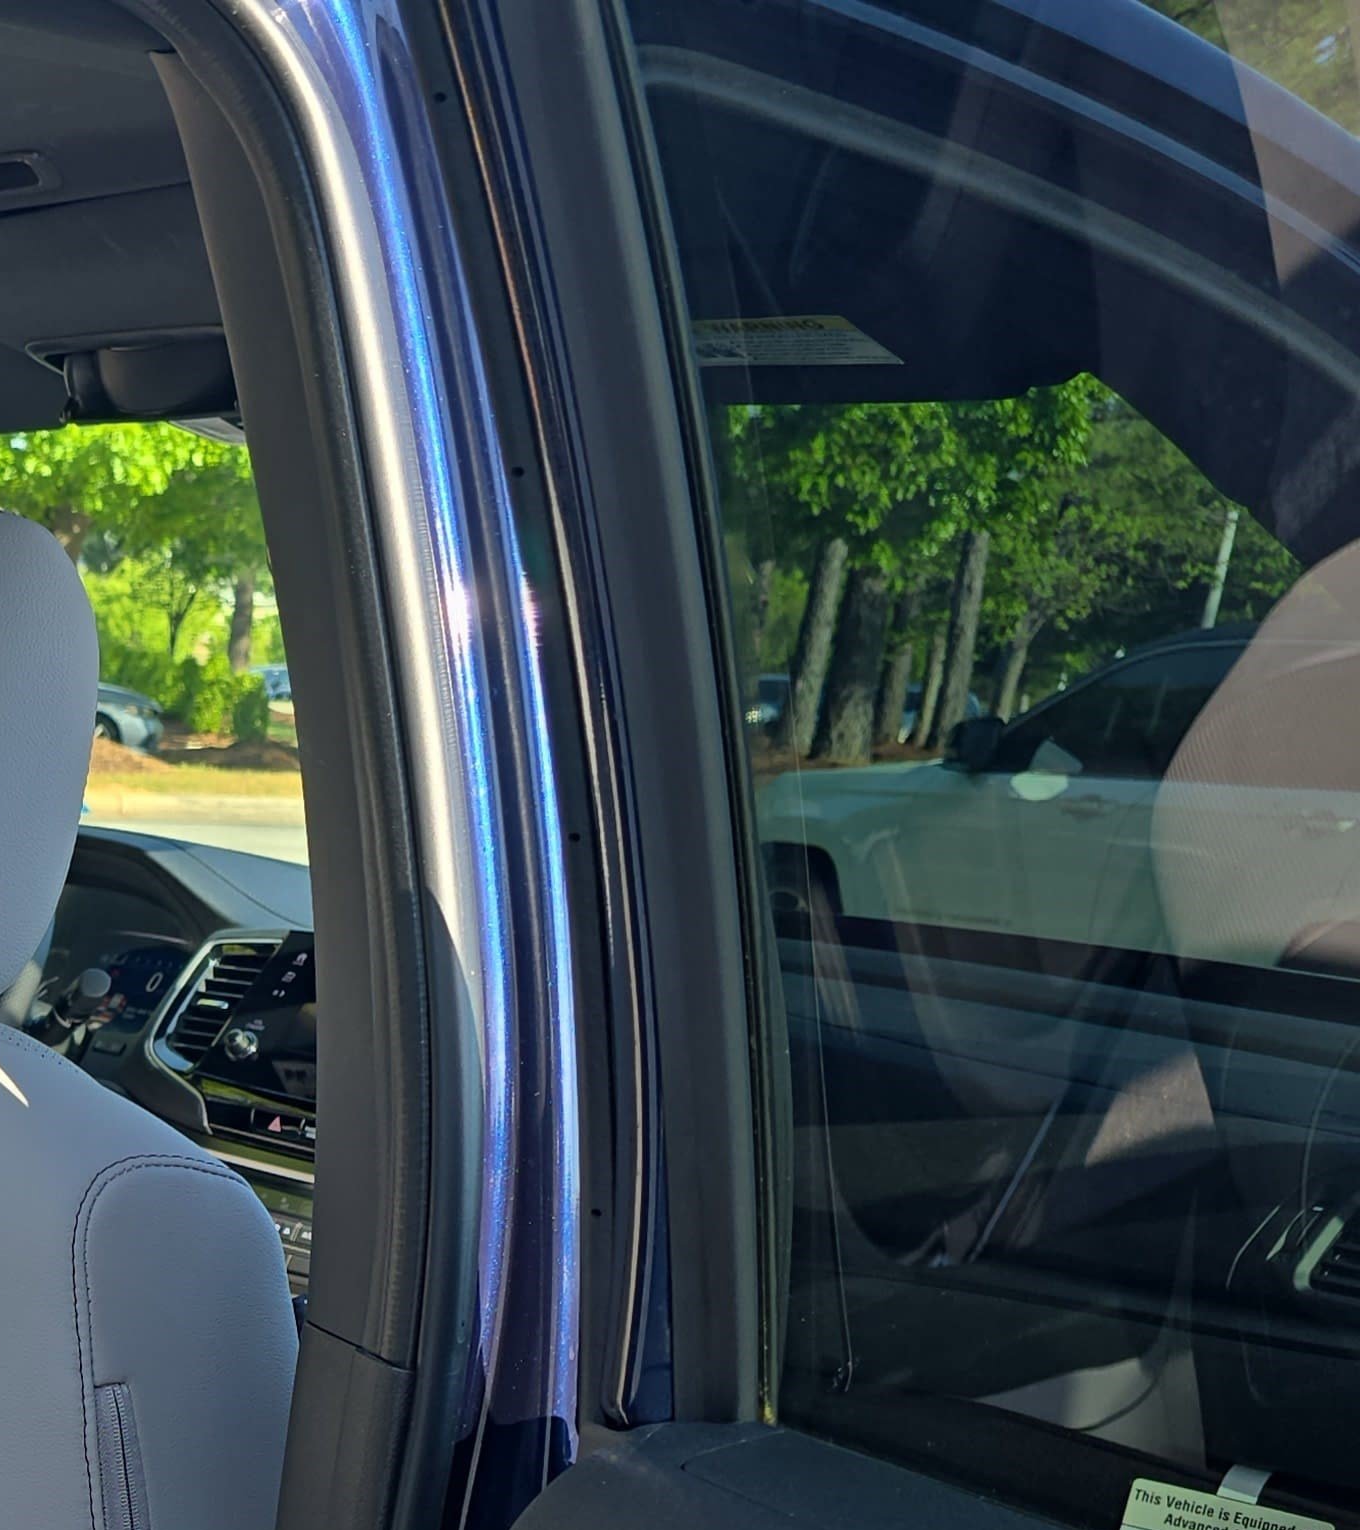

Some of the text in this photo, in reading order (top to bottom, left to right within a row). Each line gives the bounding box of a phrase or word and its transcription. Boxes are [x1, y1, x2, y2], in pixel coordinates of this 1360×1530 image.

[145, 971, 164, 993] 0
[1135, 1488, 1162, 1506] This
[1166, 1495, 1215, 1518] Vehicle
[1218, 1507, 1231, 1521] is
